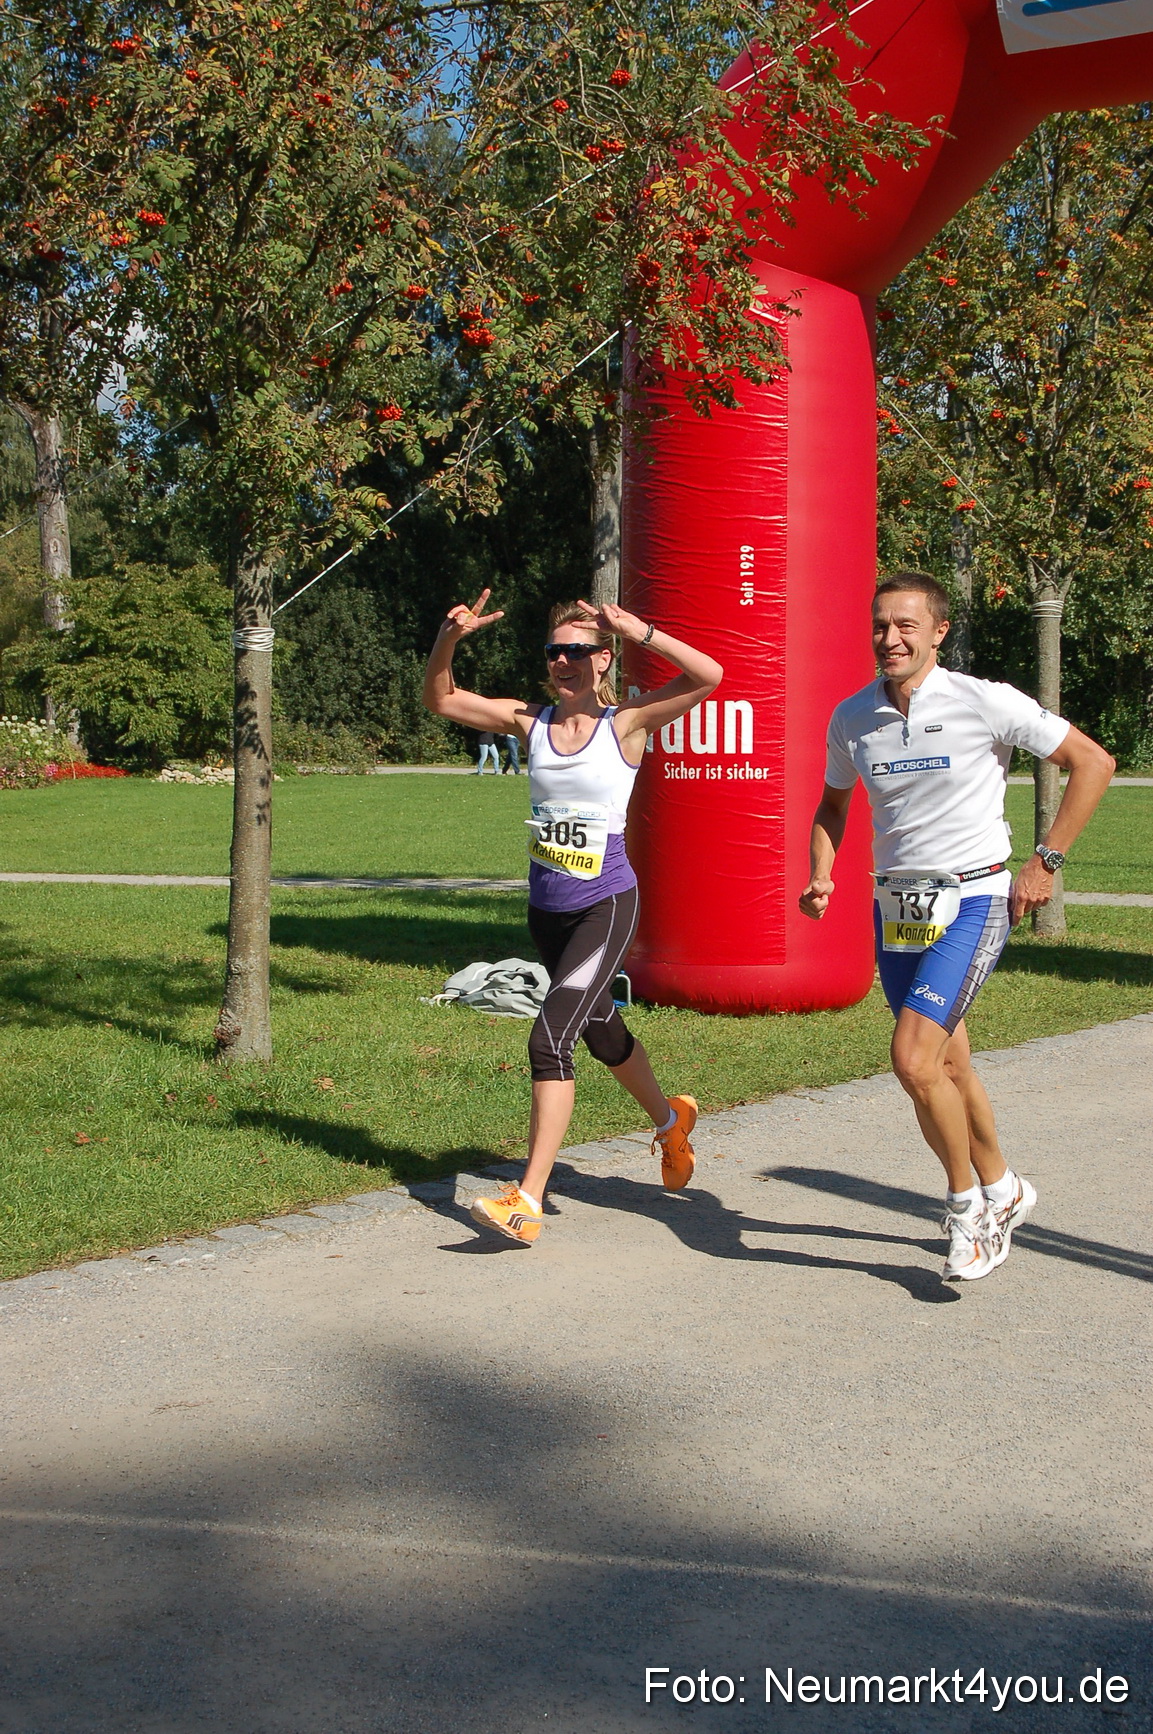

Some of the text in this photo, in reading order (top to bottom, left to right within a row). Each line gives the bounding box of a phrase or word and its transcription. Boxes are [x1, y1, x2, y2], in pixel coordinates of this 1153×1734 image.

[740, 545, 755, 606] Seit 1929
[664, 761, 770, 780] Sicher ist sicher
[893, 759, 947, 772] BÜSCHEL
[540, 820, 587, 849] 305
[532, 840, 594, 869] Katharina
[890, 891, 939, 920] 737
[896, 923, 937, 942] Konrad
